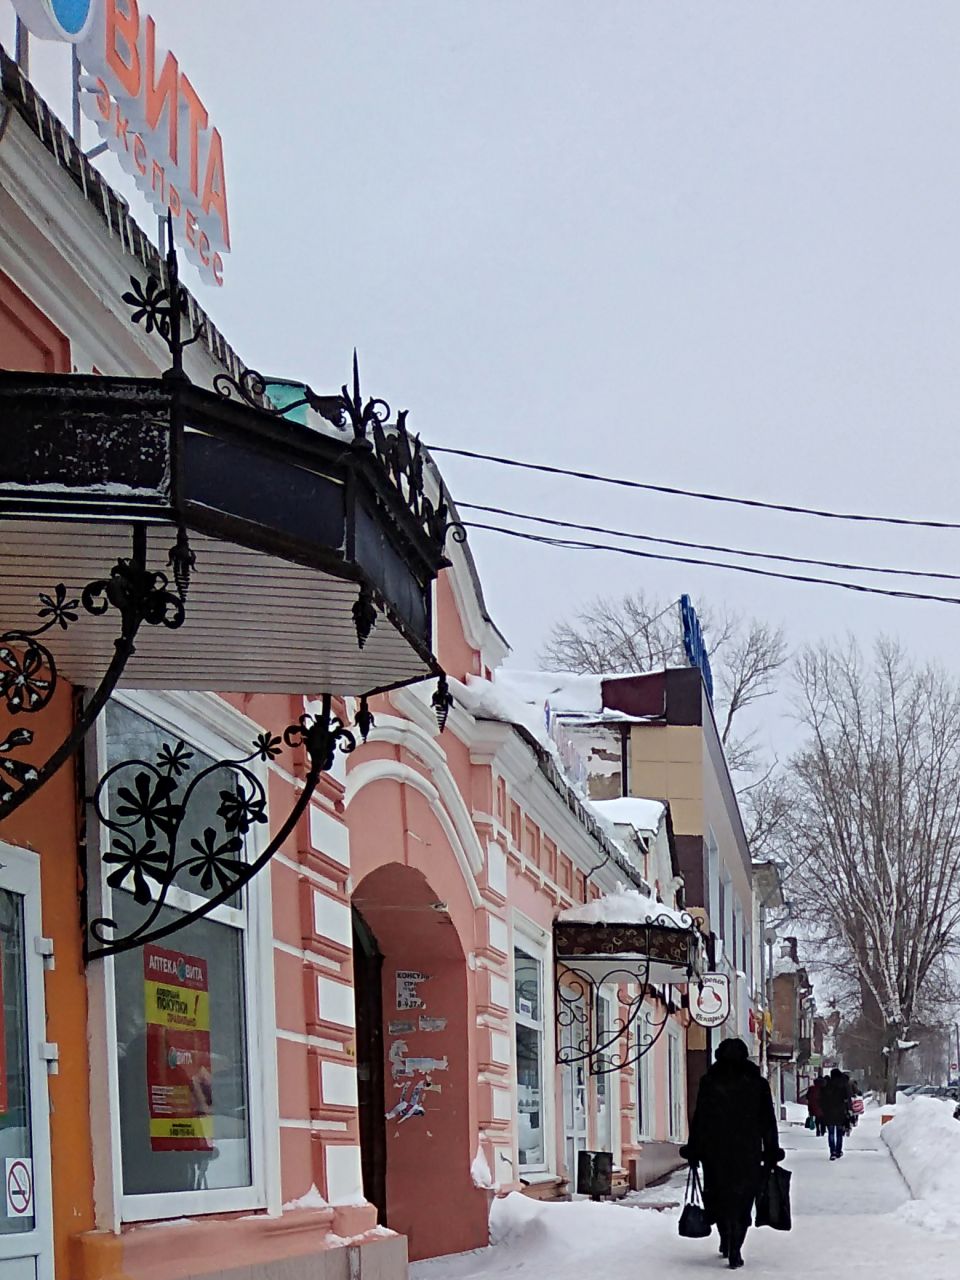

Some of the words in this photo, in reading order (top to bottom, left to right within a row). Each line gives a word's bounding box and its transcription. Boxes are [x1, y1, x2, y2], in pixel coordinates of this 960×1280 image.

[96, 77, 223, 287] ЭКСПРЕСС
[105, 0, 231, 253] ВИТА
[149, 955, 178, 975] АПТЕКА
[185, 965, 203, 982] ВИТА
[176, 1052, 193, 1065] ВИТА
